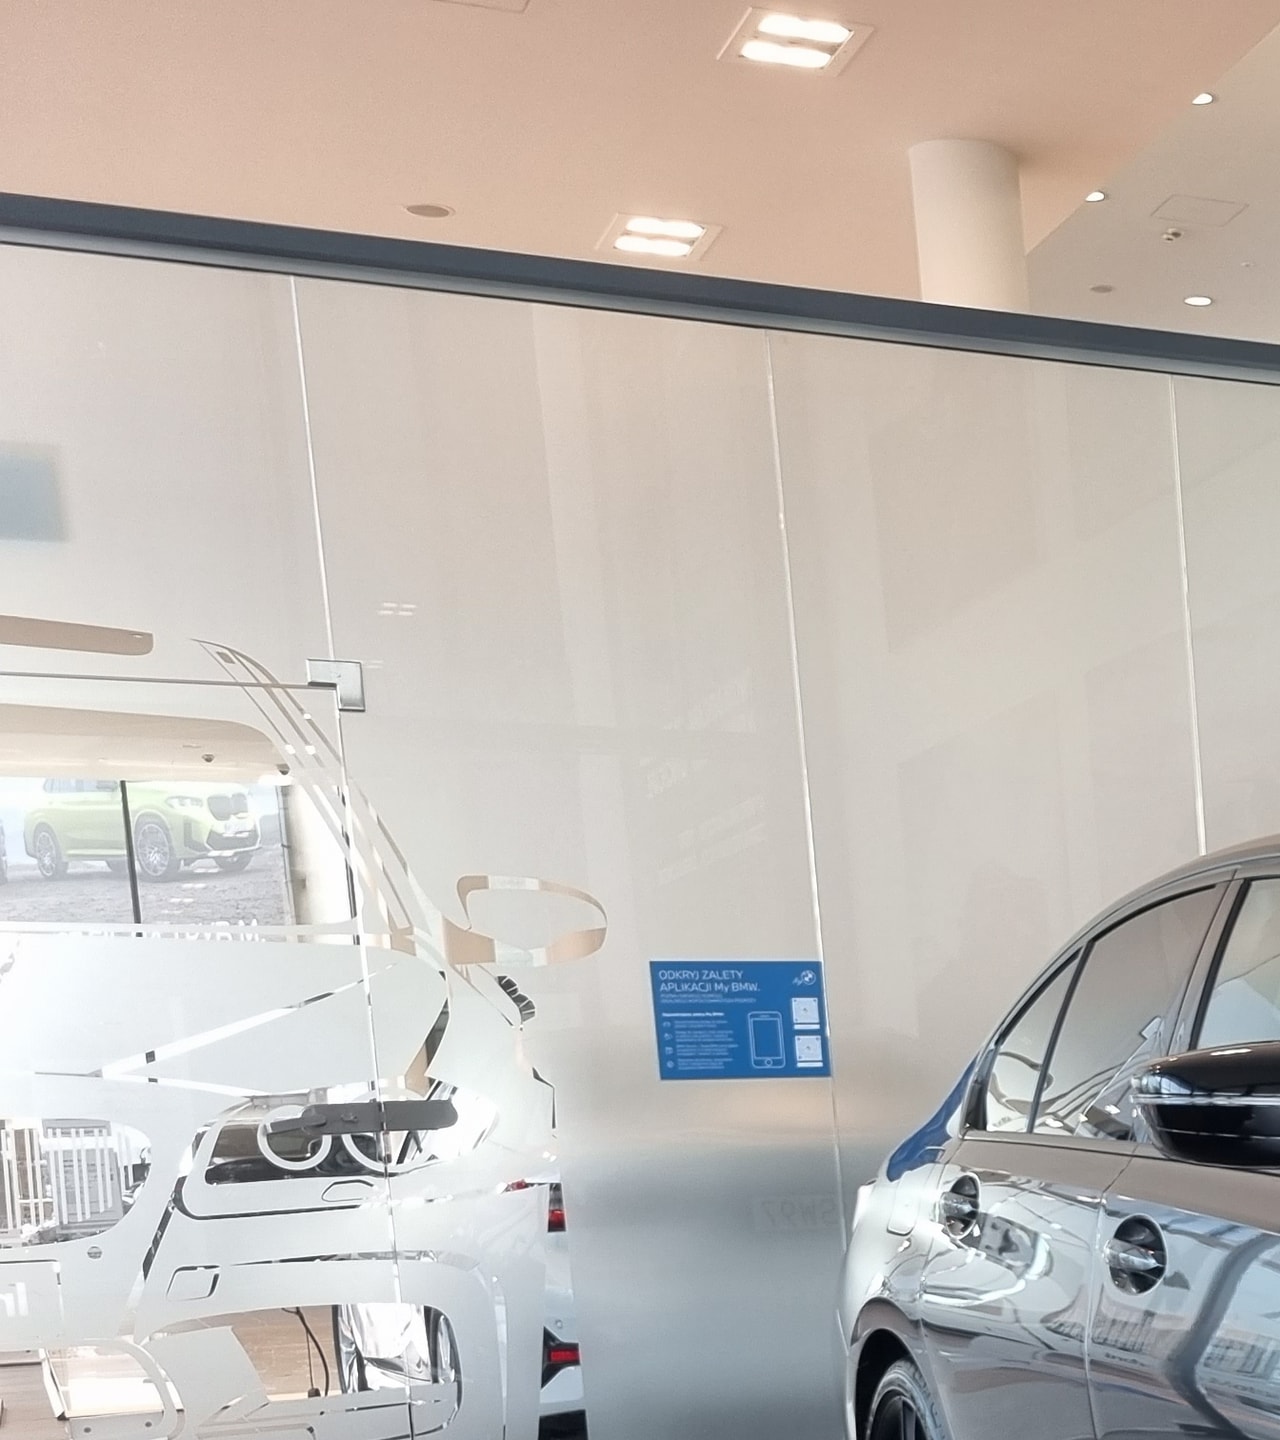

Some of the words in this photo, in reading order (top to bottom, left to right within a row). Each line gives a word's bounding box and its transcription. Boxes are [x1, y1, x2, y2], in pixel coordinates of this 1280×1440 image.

[658, 969, 700, 981] ODKRYJ
[702, 969, 744, 980] ZALETY
[659, 981, 712, 992] APLIKACJI
[714, 982, 730, 993] My
[731, 981, 761, 992] BMW.
